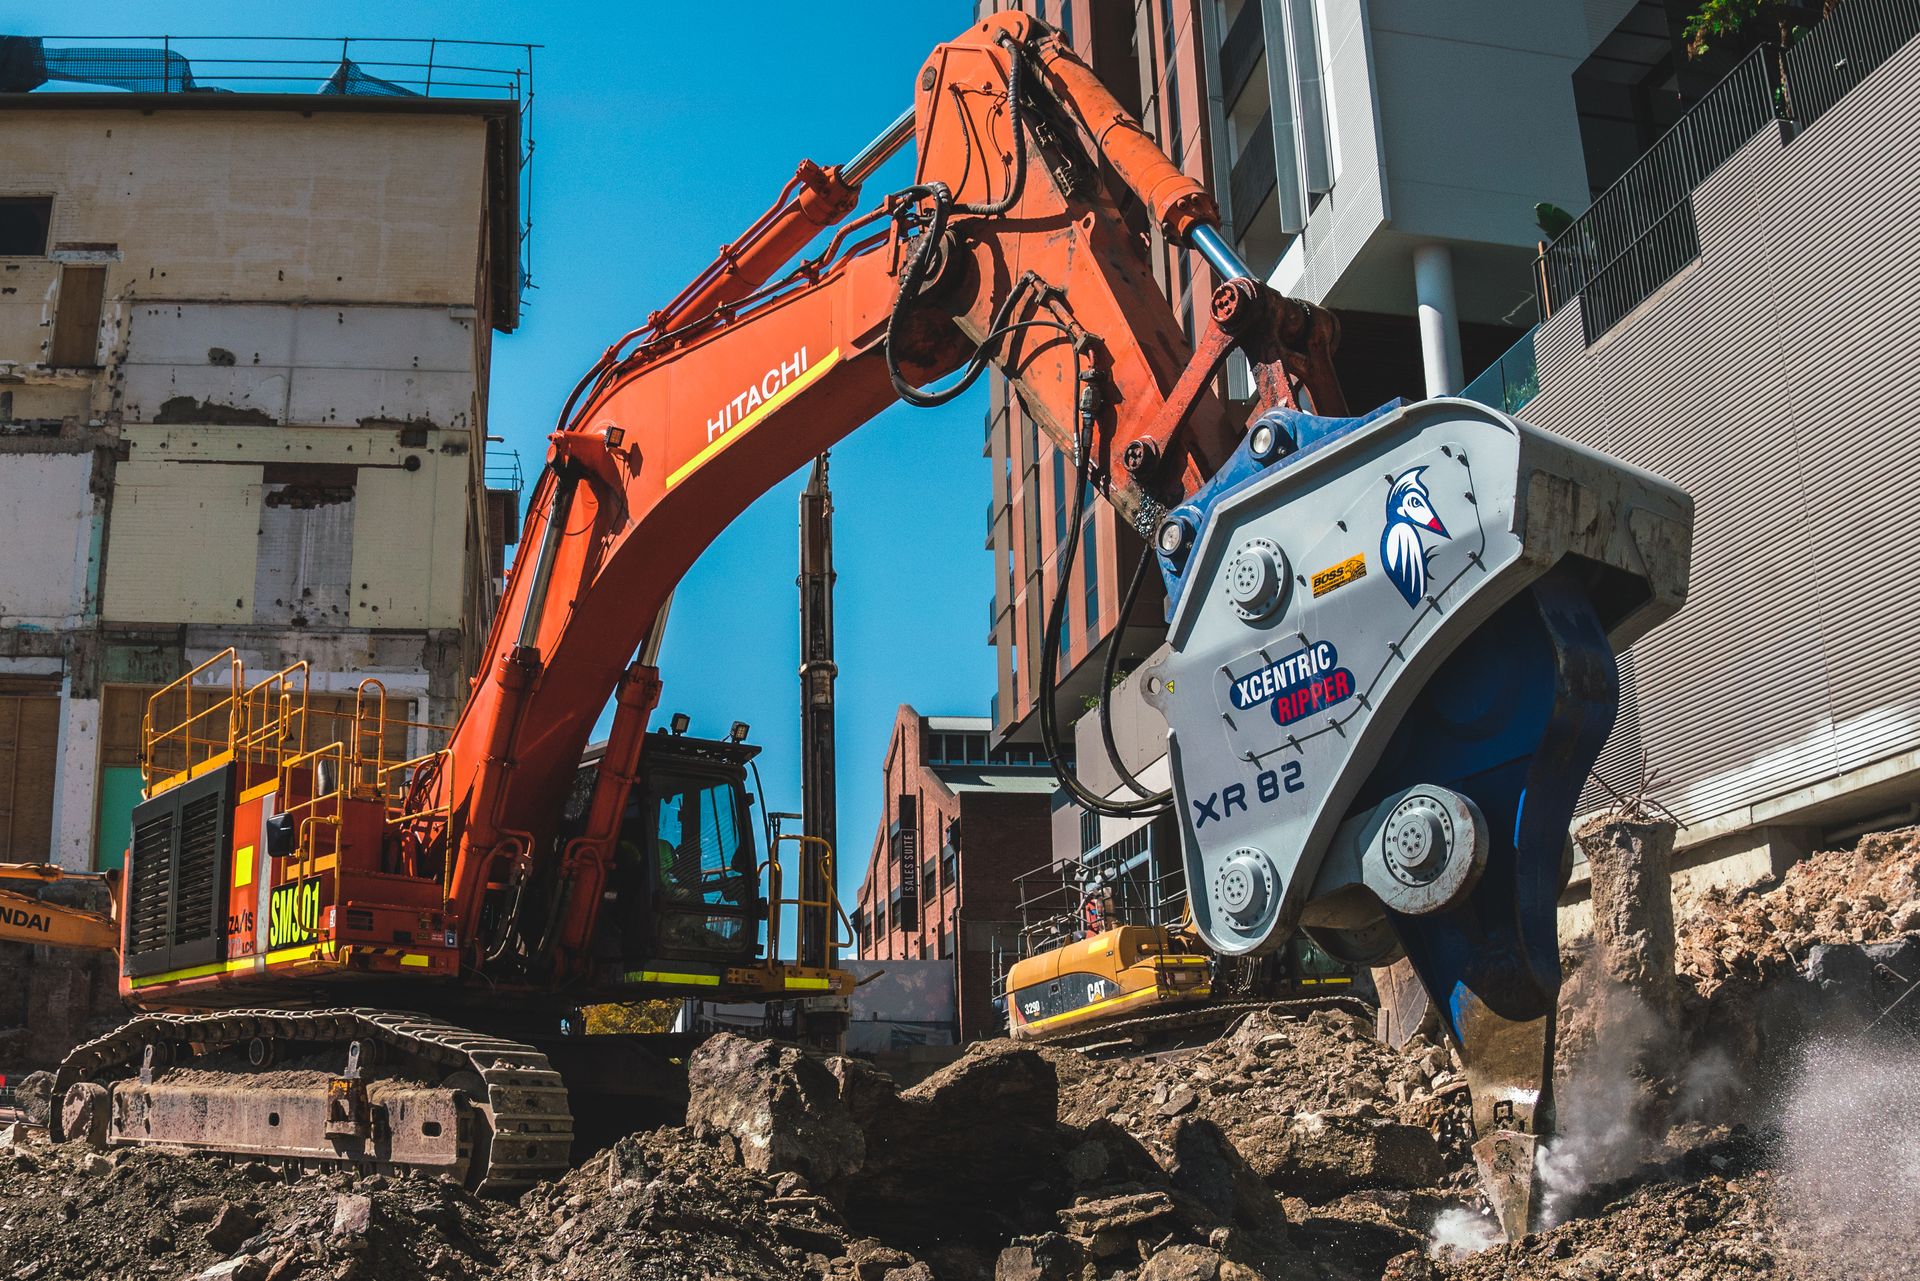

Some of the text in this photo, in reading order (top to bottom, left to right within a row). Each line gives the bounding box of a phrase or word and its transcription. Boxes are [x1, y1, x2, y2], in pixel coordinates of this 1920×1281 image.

[707, 345, 808, 443] HITACHI
[1313, 566, 1345, 588] BOSS
[1236, 643, 1331, 708] XCENTRIC
[1277, 671, 1349, 724] RIPPER
[1192, 760, 1305, 829] XR 82
[903, 834, 914, 892] SALES SUITE
[270, 881, 319, 947] SMS01
[1087, 979, 1106, 1003] CAT
